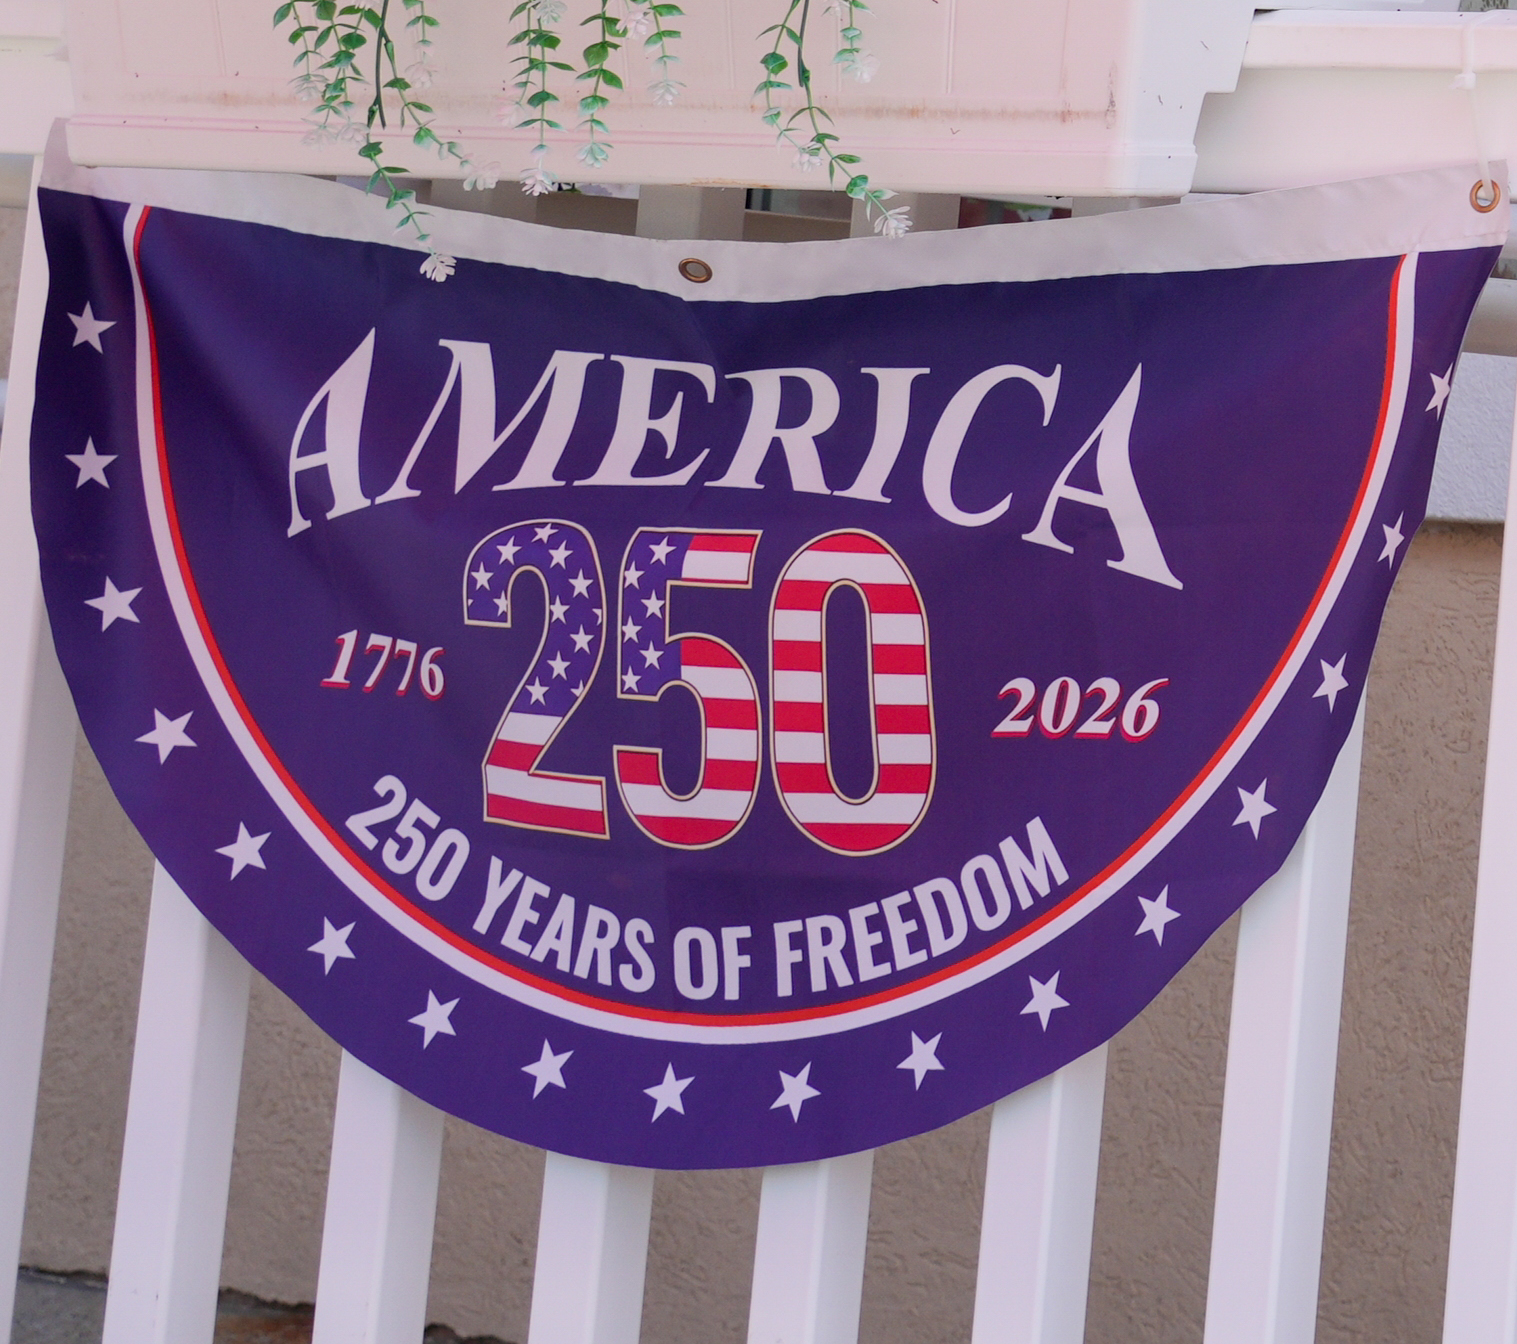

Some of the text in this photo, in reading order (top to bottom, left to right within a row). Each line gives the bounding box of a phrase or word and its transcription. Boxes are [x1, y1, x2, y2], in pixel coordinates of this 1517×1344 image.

[284, 326, 1184, 591] AMERICA
[320, 629, 446, 701] 1776
[461, 517, 939, 857] 250
[990, 675, 1171, 741] 2026
[345, 774, 1070, 1002] 250 YEARS OF FREEDOM
